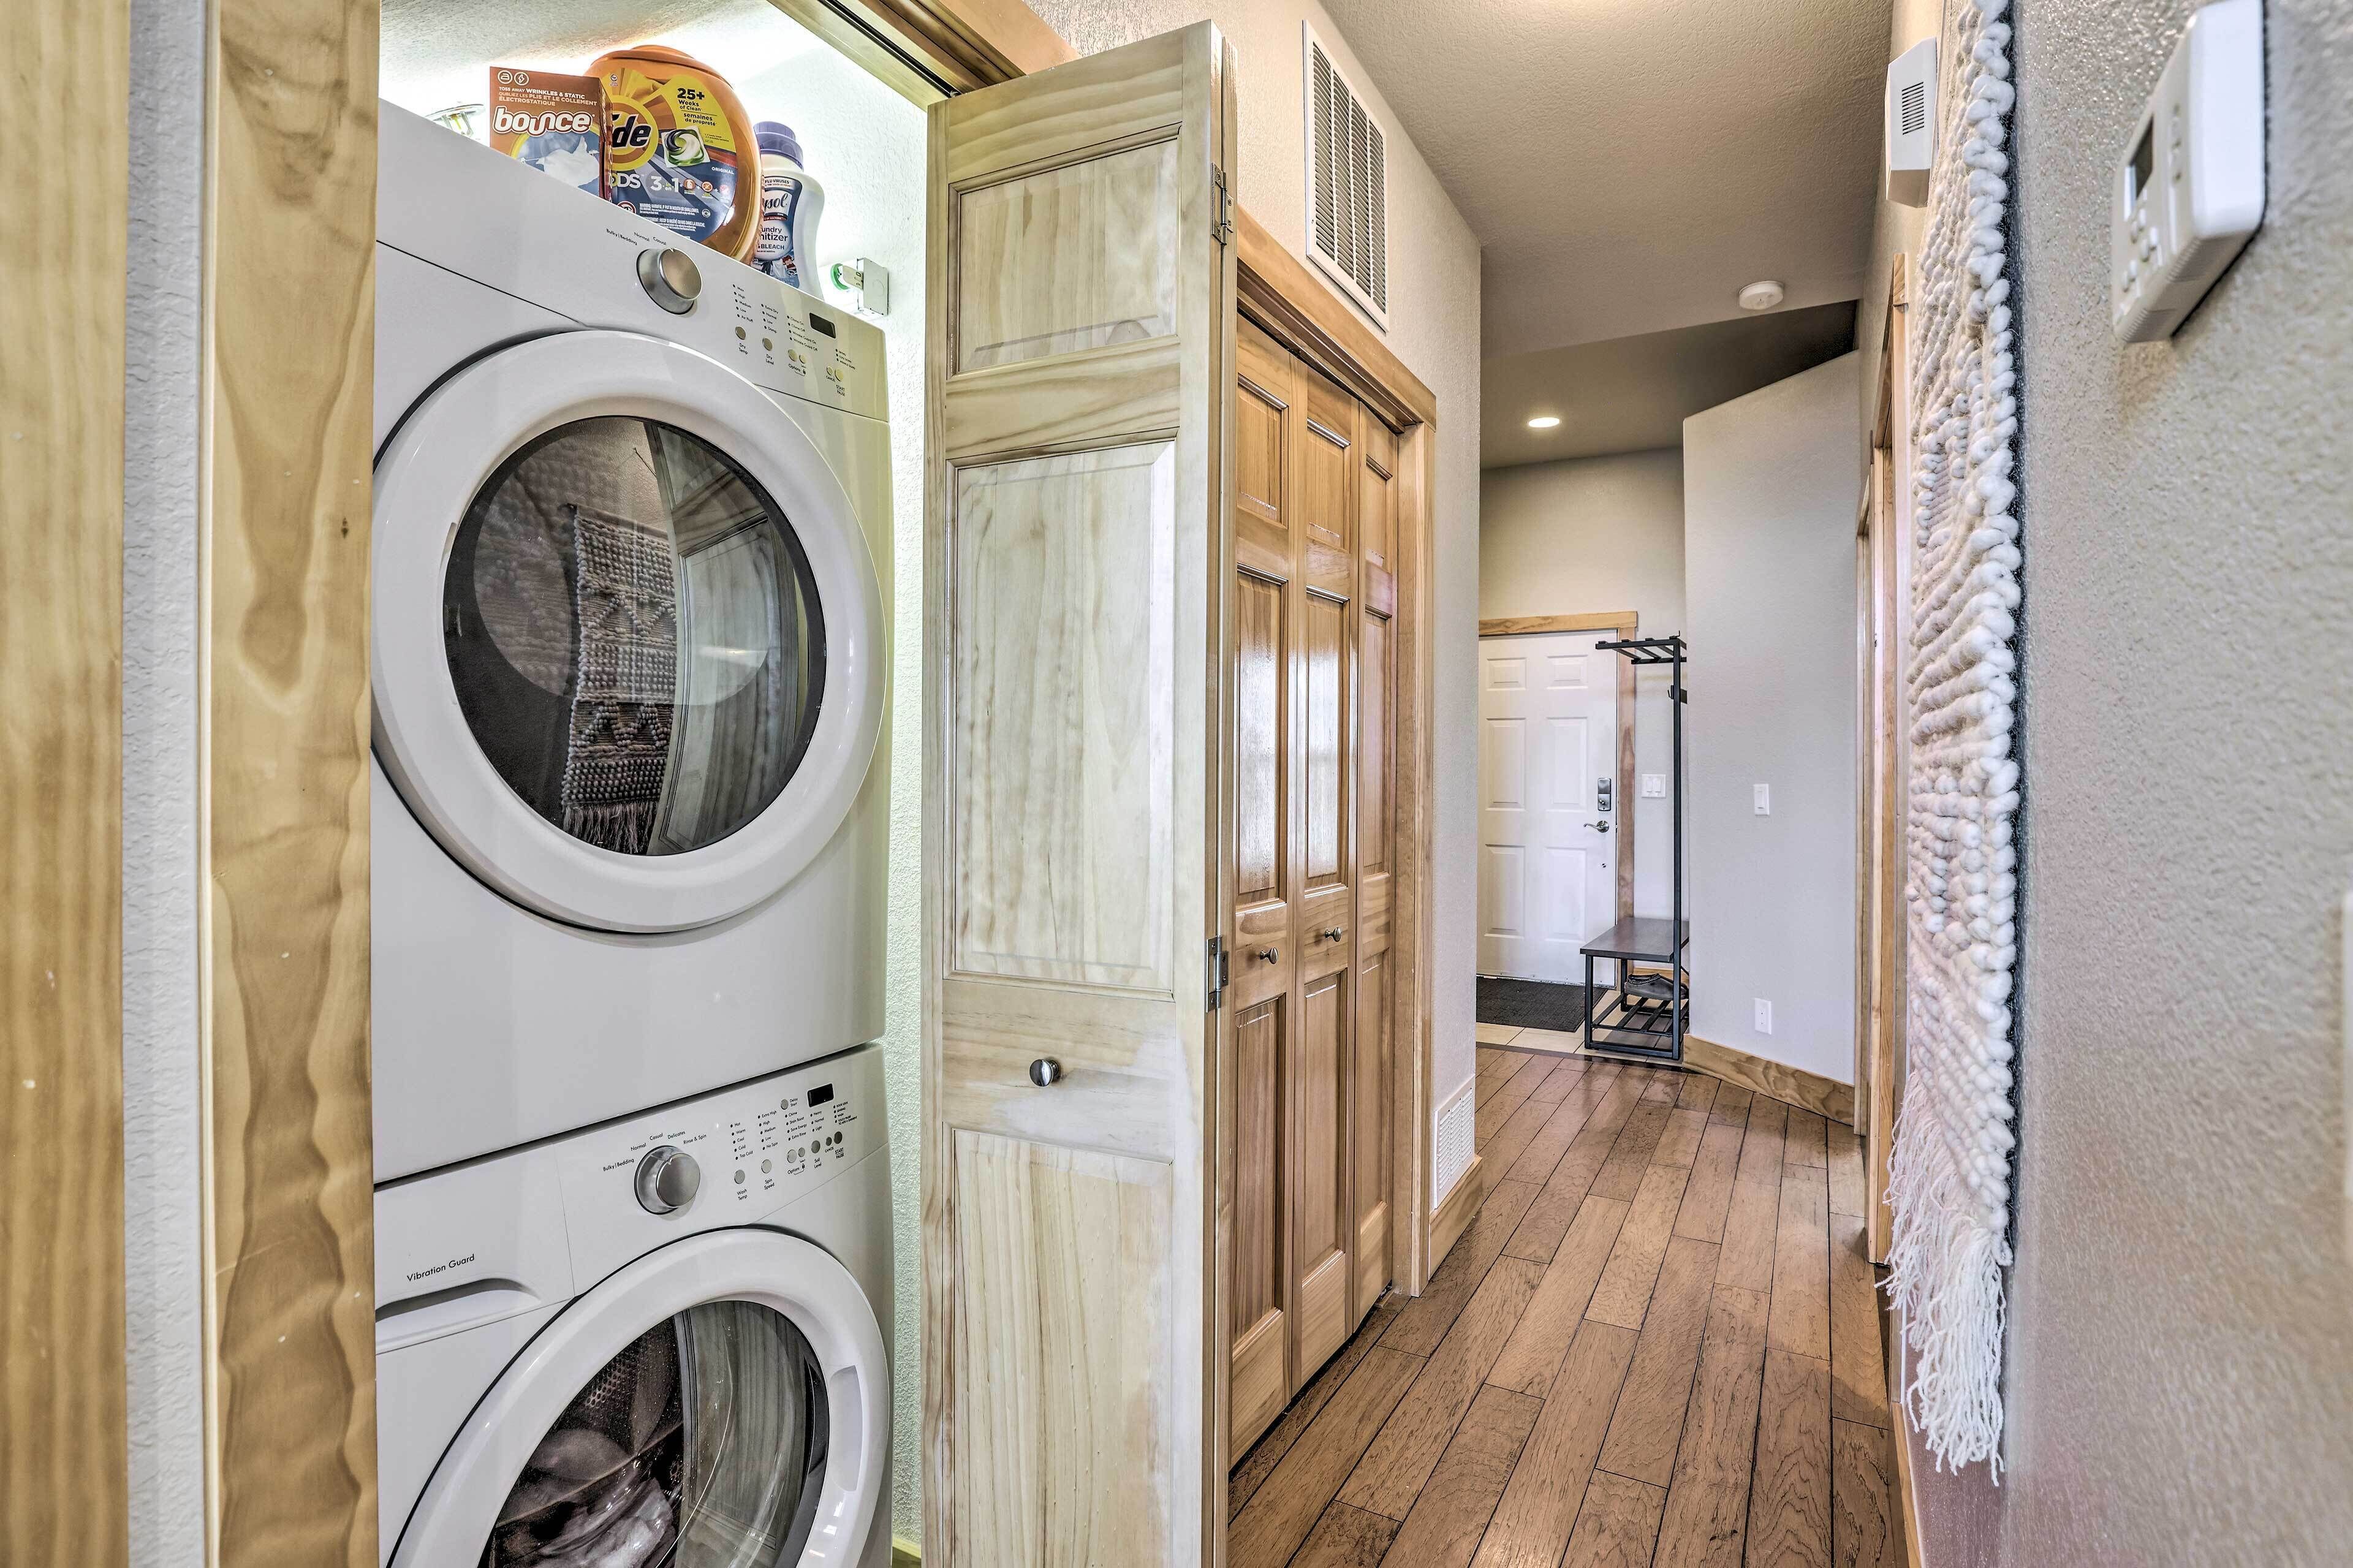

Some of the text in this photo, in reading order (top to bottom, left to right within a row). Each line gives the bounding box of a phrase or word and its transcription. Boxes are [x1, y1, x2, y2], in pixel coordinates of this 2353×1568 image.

[526, 88, 558, 96] WRINKLES
[677, 88, 705, 100] 25+
[561, 97, 597, 106] COLLEMENT
[493, 106, 593, 137] bounce
[650, 175, 662, 191] 3
[671, 178, 679, 193] 1
[760, 233, 788, 241] nitizer
[667, 1131, 686, 1140] Delicates
[631, 1143, 647, 1151] Normal
[406, 1253, 476, 1282] Vibration Guard
